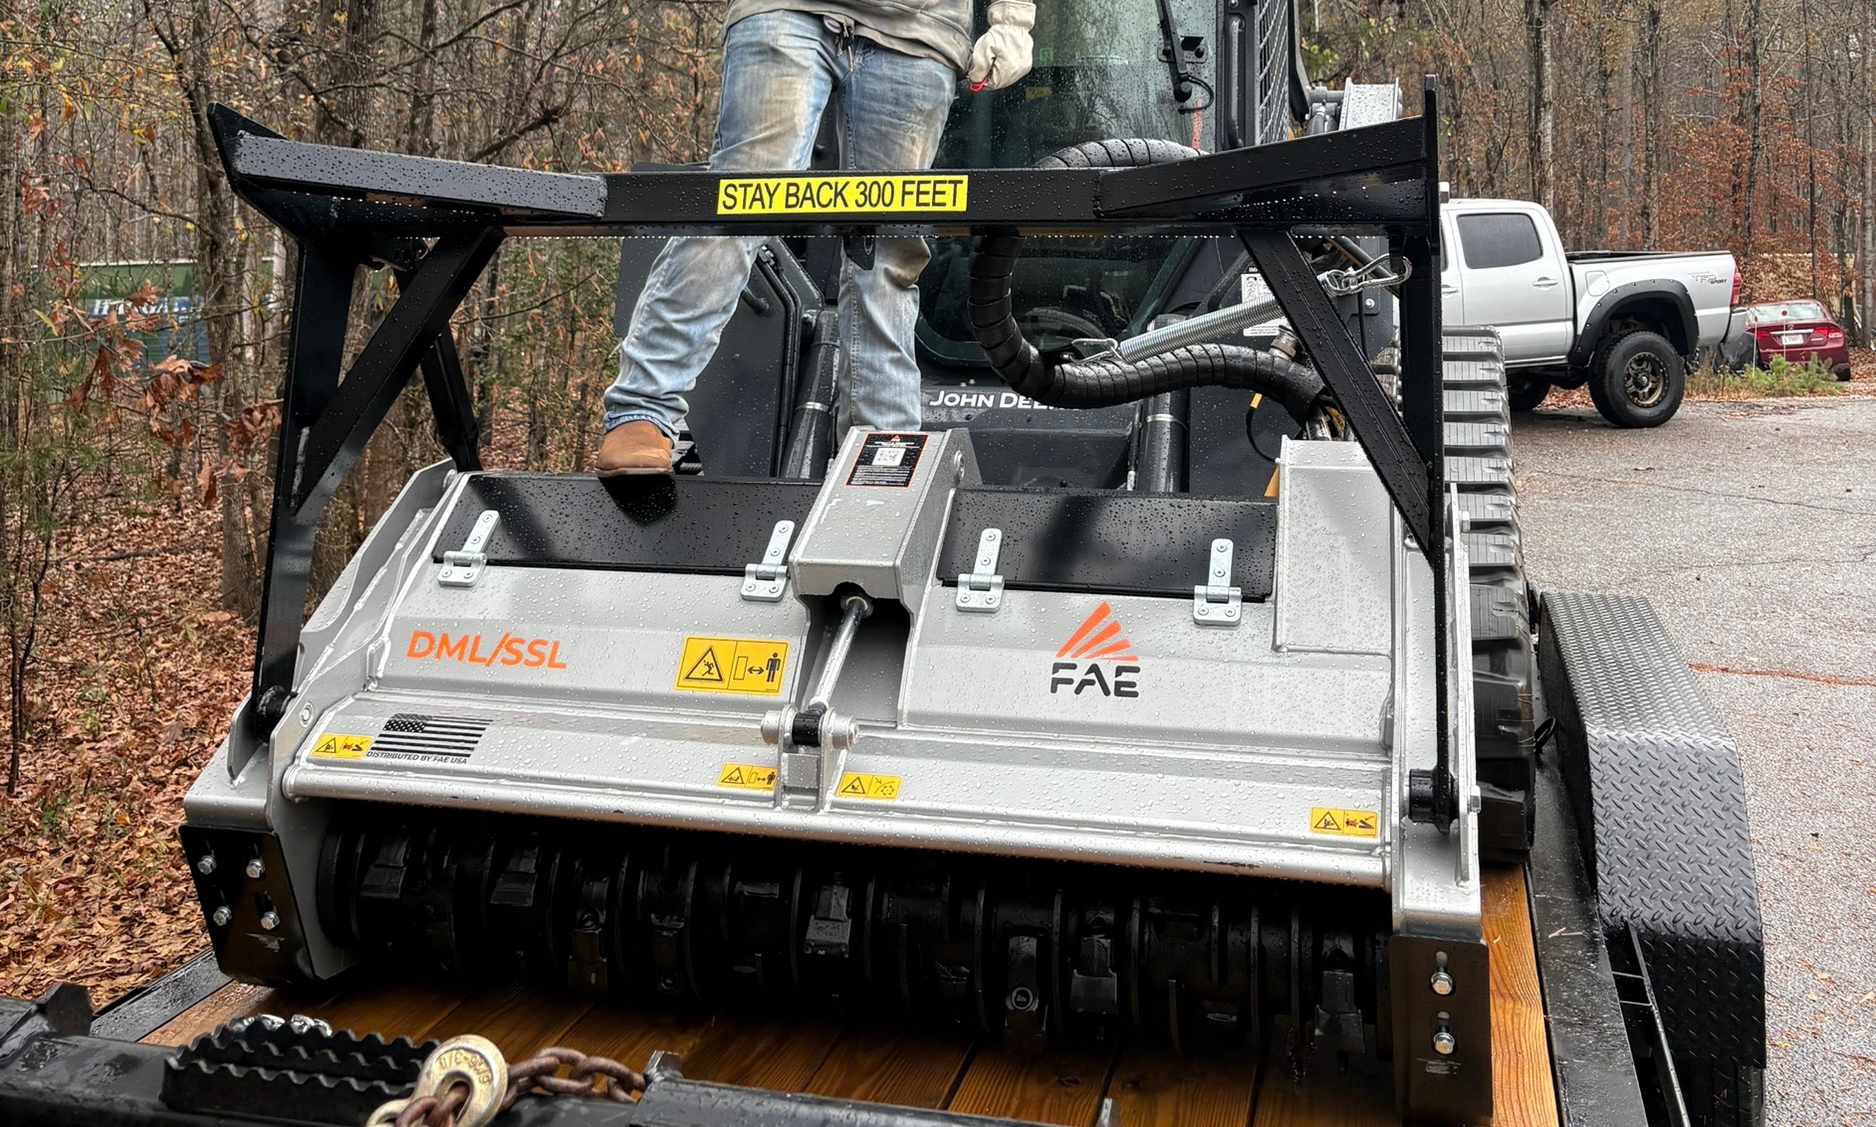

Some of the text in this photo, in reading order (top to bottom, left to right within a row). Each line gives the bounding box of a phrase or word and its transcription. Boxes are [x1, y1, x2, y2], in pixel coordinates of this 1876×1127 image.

[722, 179, 964, 210] STAY BACK 300 FEET
[929, 390, 995, 408] JOHN
[406, 629, 567, 670] DML/SSL
[1050, 662, 1141, 698] FAE
[366, 751, 468, 765] DISTRIBUTED BY FAE USA
